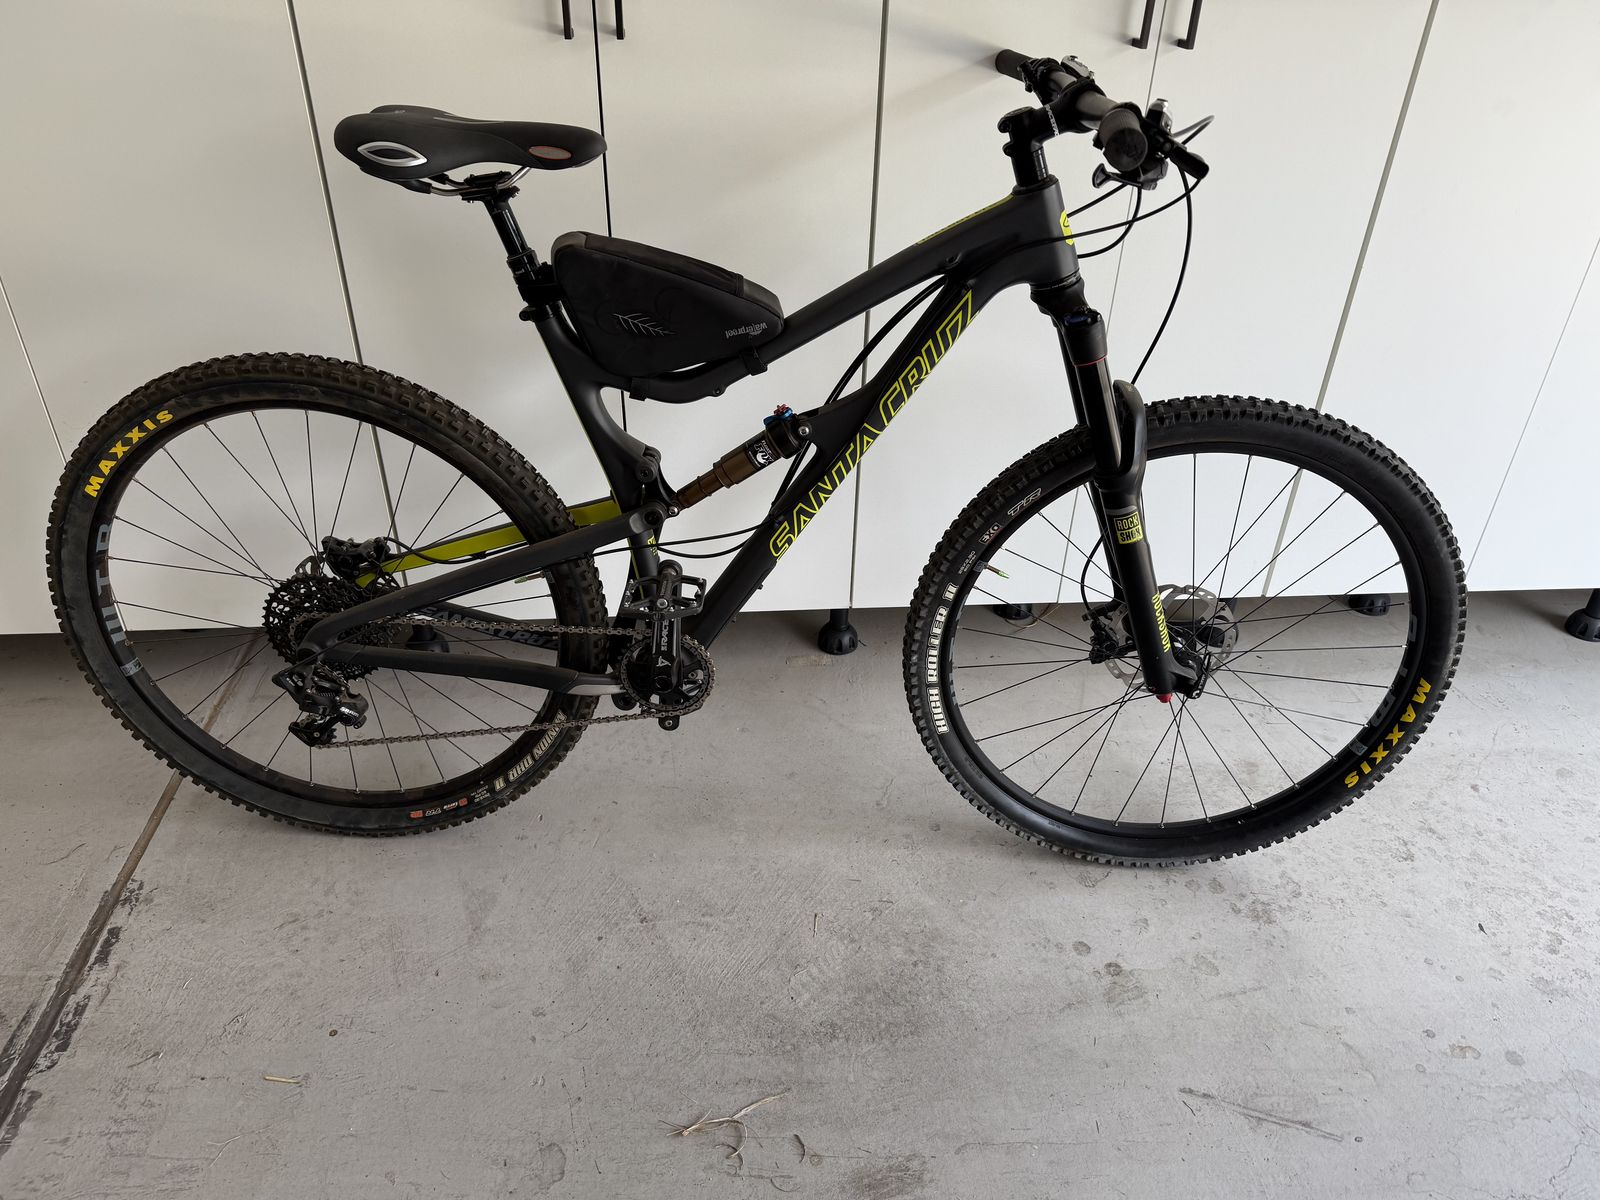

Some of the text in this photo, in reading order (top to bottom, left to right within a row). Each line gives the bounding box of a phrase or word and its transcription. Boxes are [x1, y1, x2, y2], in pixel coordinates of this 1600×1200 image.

[725, 322, 768, 339] waterproof
[84, 410, 174, 497] MAXXIS
[769, 422, 884, 561] SANTA
[879, 289, 981, 427] CRUZ
[981, 523, 1002, 543] EXO
[1116, 514, 1140, 531] ROCK
[925, 582, 959, 735] HIGH ROLLER II
[1344, 677, 1432, 789] MAXXIS
[508, 753, 535, 783] DHR
